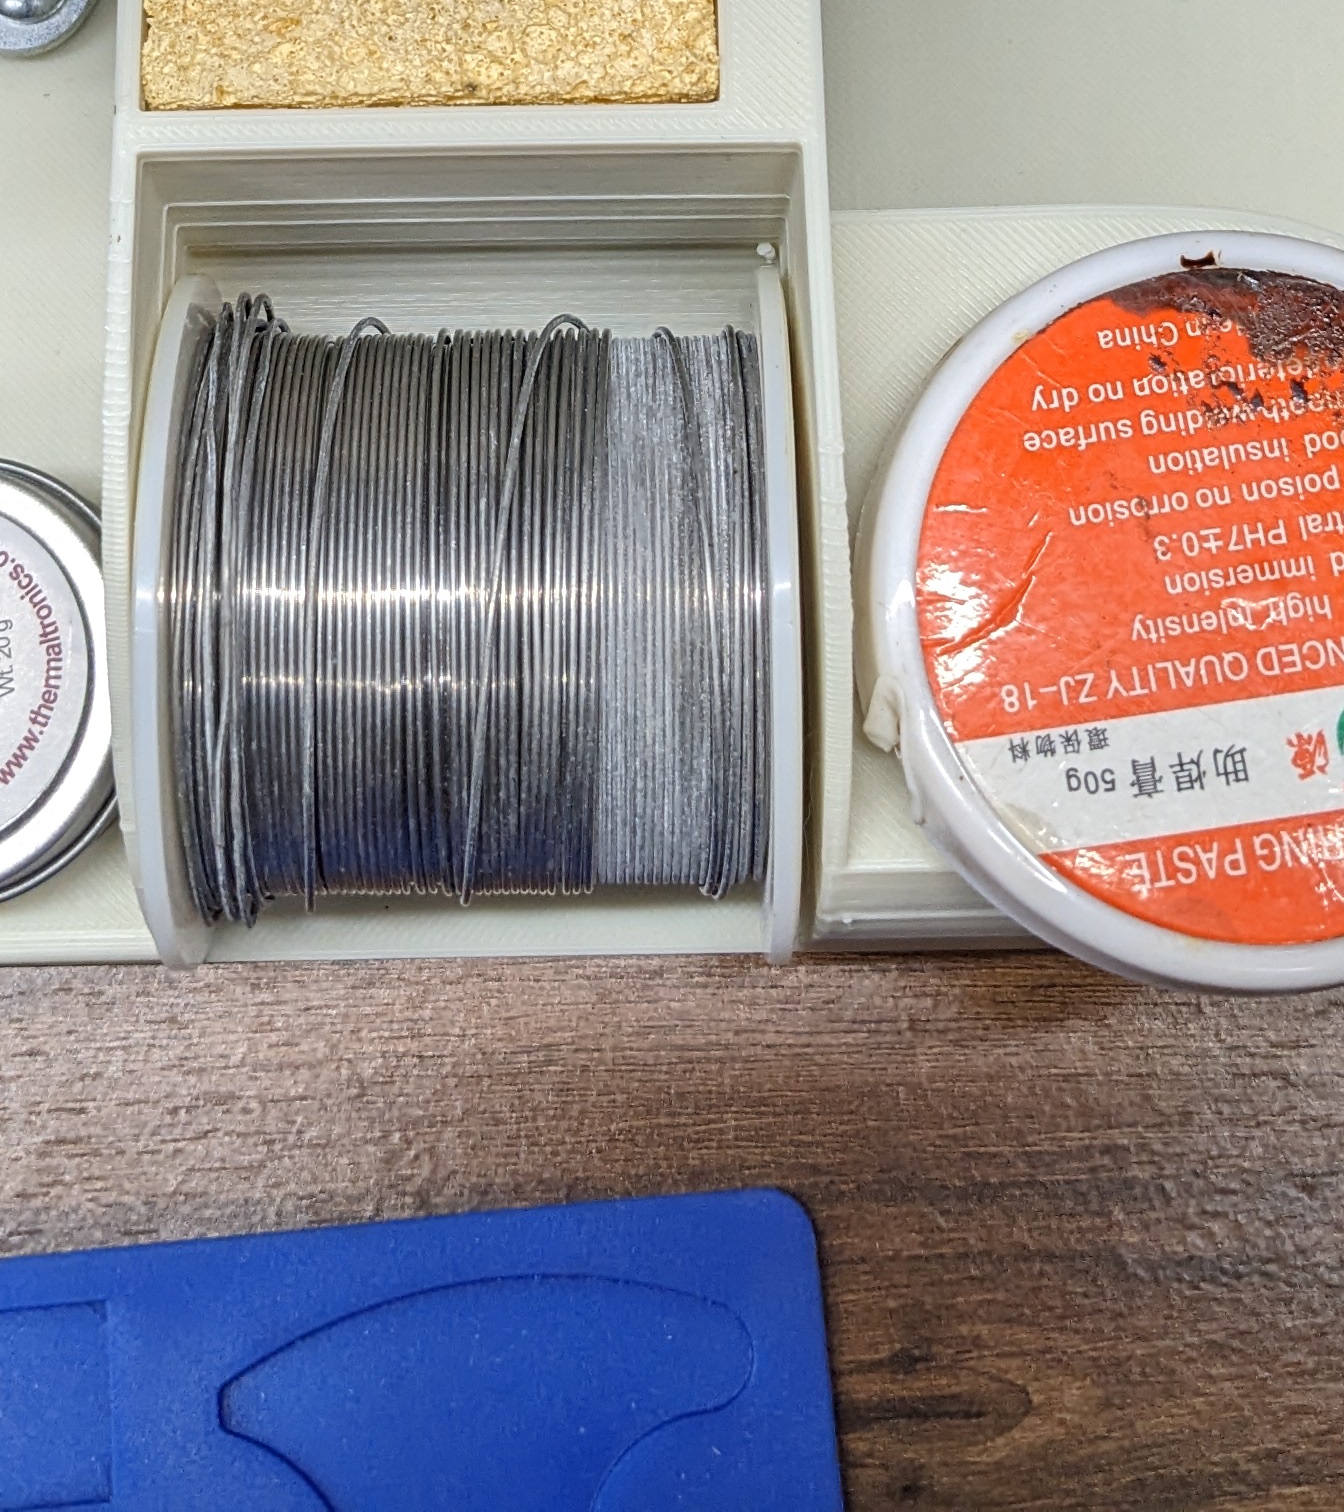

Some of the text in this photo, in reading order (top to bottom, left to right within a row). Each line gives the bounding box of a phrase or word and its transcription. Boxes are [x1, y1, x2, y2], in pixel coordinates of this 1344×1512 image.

[1096, 321, 1179, 351] China
[1031, 384, 1079, 413] dry
[1088, 380, 1123, 403] no
[1022, 418, 1134, 453] surface
[1147, 437, 1290, 475] insulation
[1195, 485, 1231, 509] no
[1241, 464, 1340, 502] poison
[1068, 492, 1189, 527] orrosion
[1153, 518, 1287, 561] PH7±0.3
[1164, 555, 1316, 596] immersion
[1269, 591, 1332, 627] high
[1000, 671, 1097, 712] ZJ-18
[1106, 651, 1248, 698] QUALITY
[1007, 726, 1110, 763] 環保物料
[1064, 744, 1250, 798] 助焊膏 50g
[1126, 837, 1246, 893] PASTE
